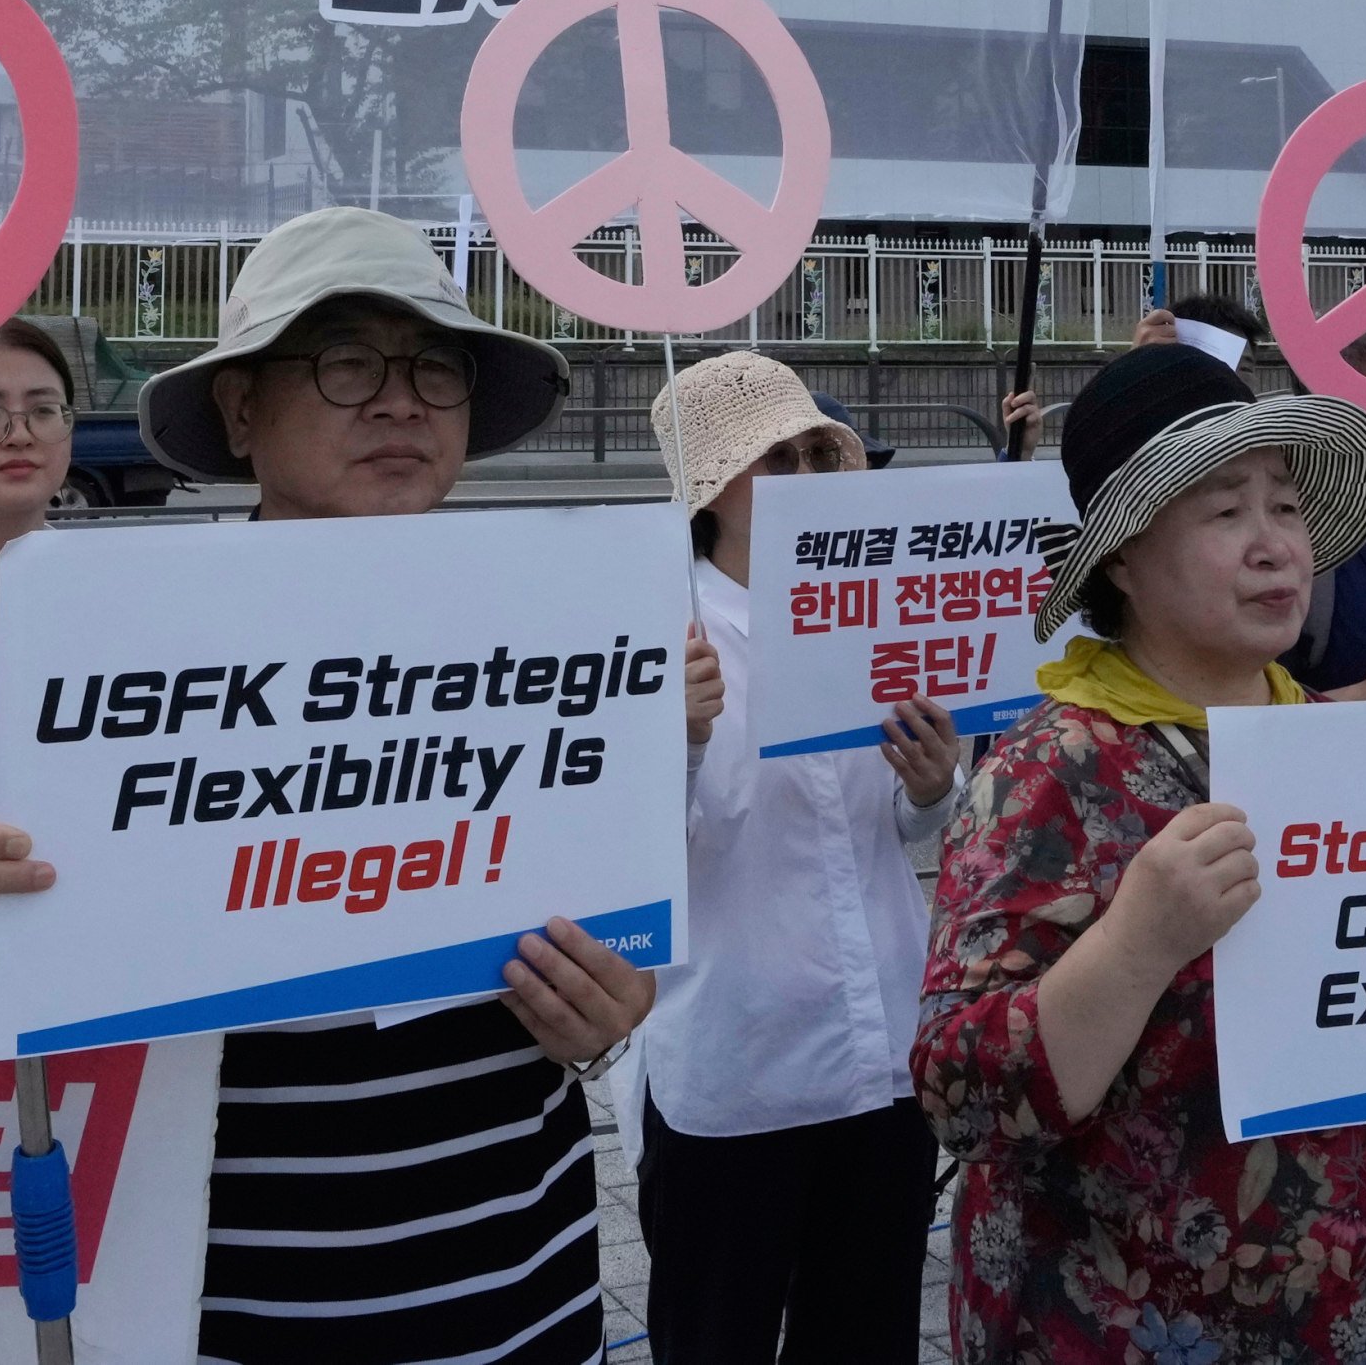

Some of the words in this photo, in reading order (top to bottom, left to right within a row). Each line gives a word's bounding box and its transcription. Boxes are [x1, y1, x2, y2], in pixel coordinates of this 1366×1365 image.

[795, 526, 895, 571] 핵대결
[907, 517, 1052, 565] 격화시키
[791, 579, 878, 635] 한미
[37, 661, 287, 744] USFK
[303, 634, 668, 723] Strategic
[870, 633, 997, 703] 중단!
[112, 735, 524, 832] Flexibility
[539, 727, 606, 789] Is
[226, 820, 469, 915] Illegal
